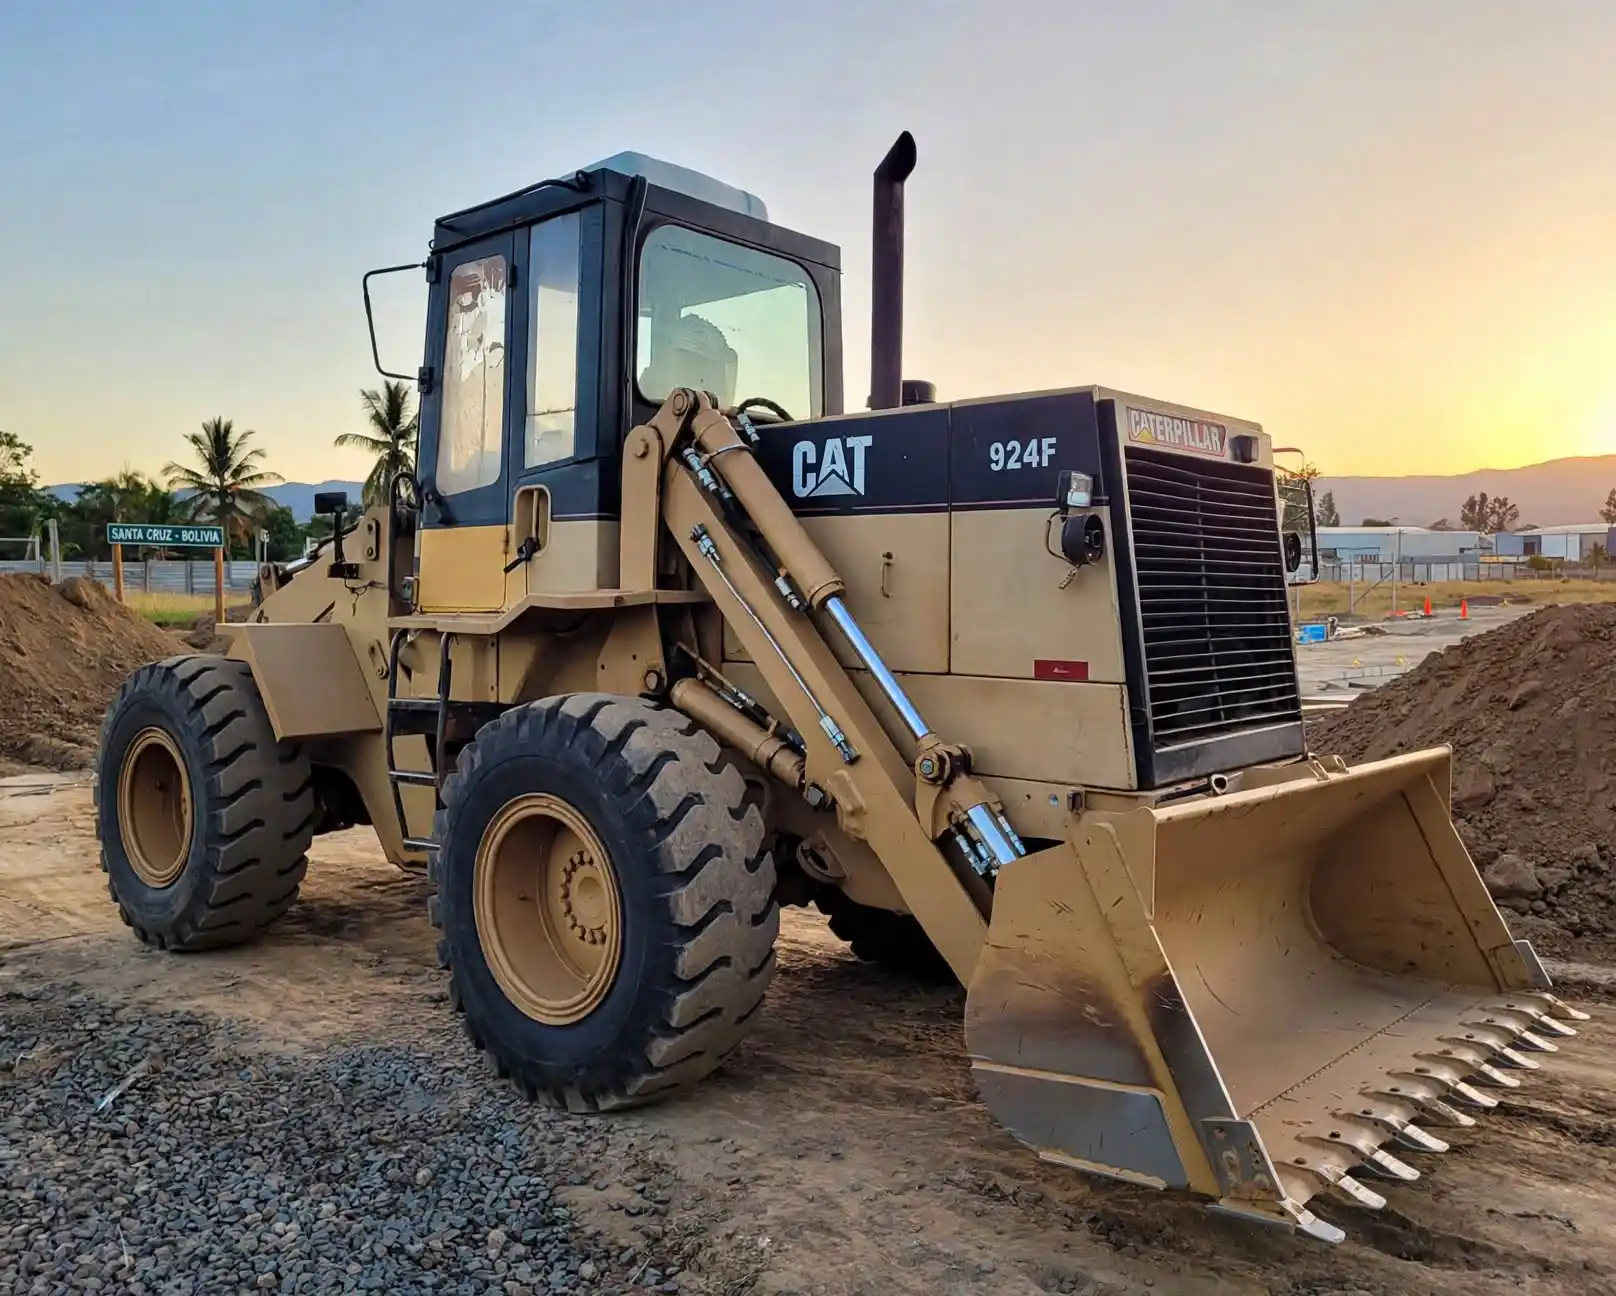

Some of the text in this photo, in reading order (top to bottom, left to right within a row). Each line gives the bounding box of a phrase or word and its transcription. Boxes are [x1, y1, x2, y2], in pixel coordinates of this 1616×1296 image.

[1130, 409, 1221, 452] CATERPILLAR
[792, 435, 873, 498] CAT
[989, 437, 1057, 472] 924F
[111, 527, 144, 540] SANTA
[146, 528, 173, 541] CRUZ
[181, 530, 220, 543] BOLIVIA
